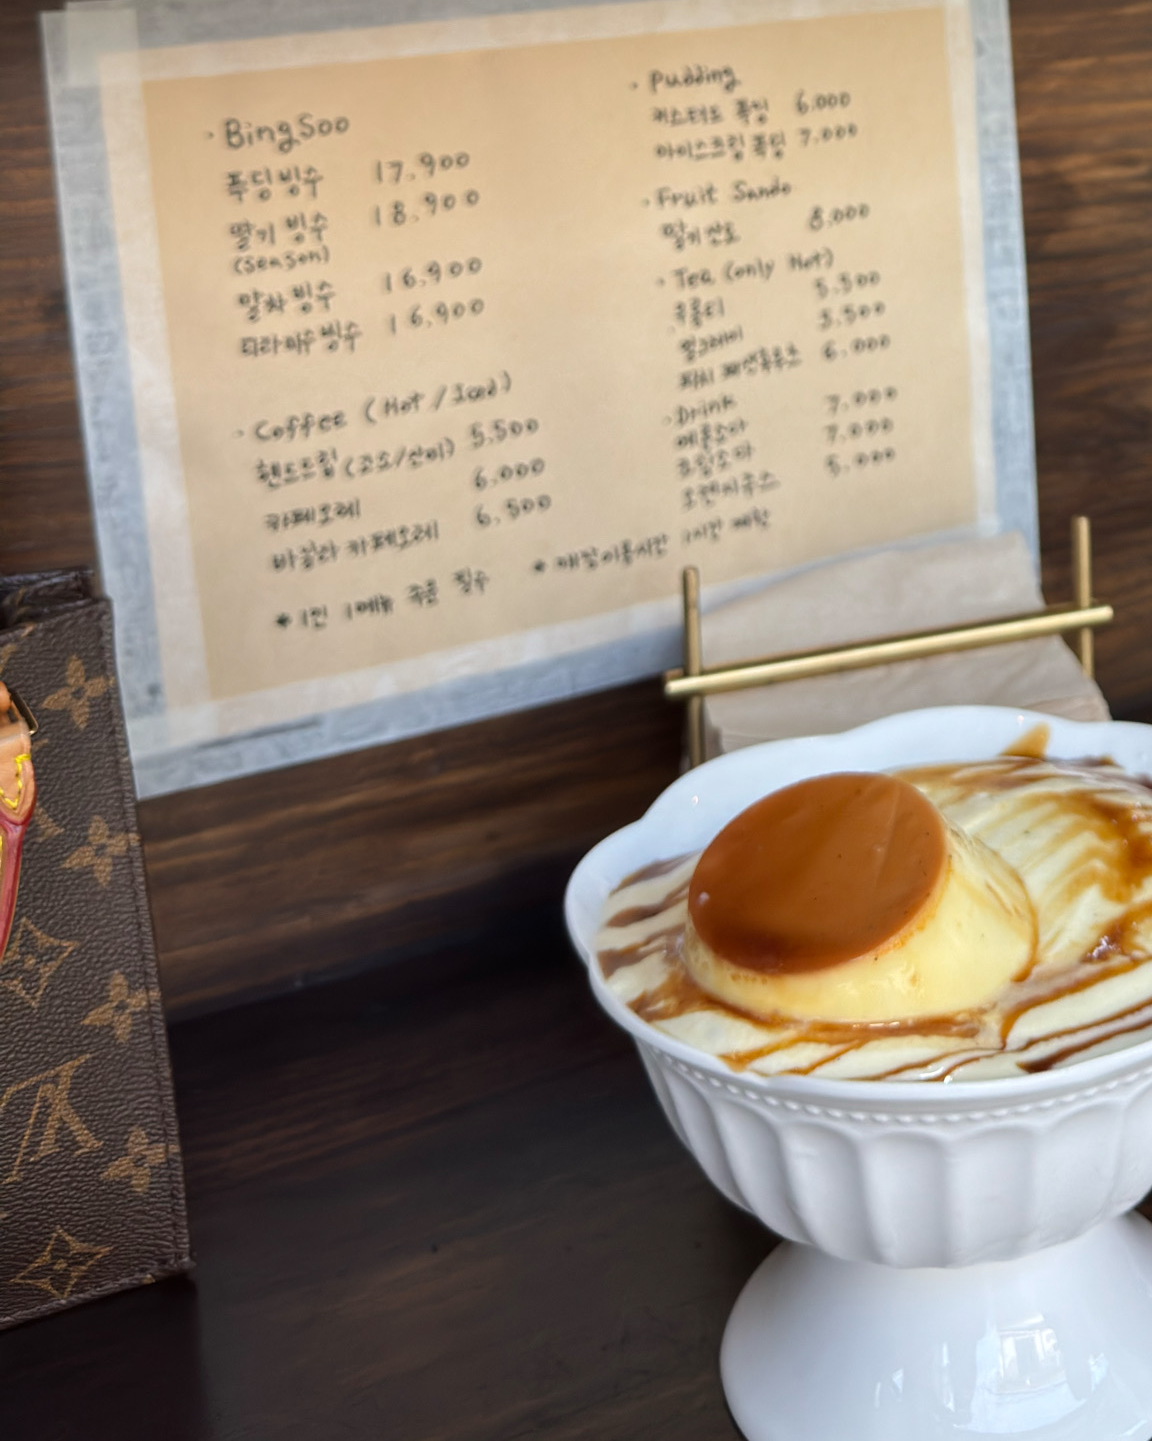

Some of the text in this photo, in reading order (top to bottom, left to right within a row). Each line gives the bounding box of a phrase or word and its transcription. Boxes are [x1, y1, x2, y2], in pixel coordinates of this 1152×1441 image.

[656, 183, 720, 209] Fruit
[671, 267, 714, 290] Tea
[253, 409, 348, 444] Coffee
